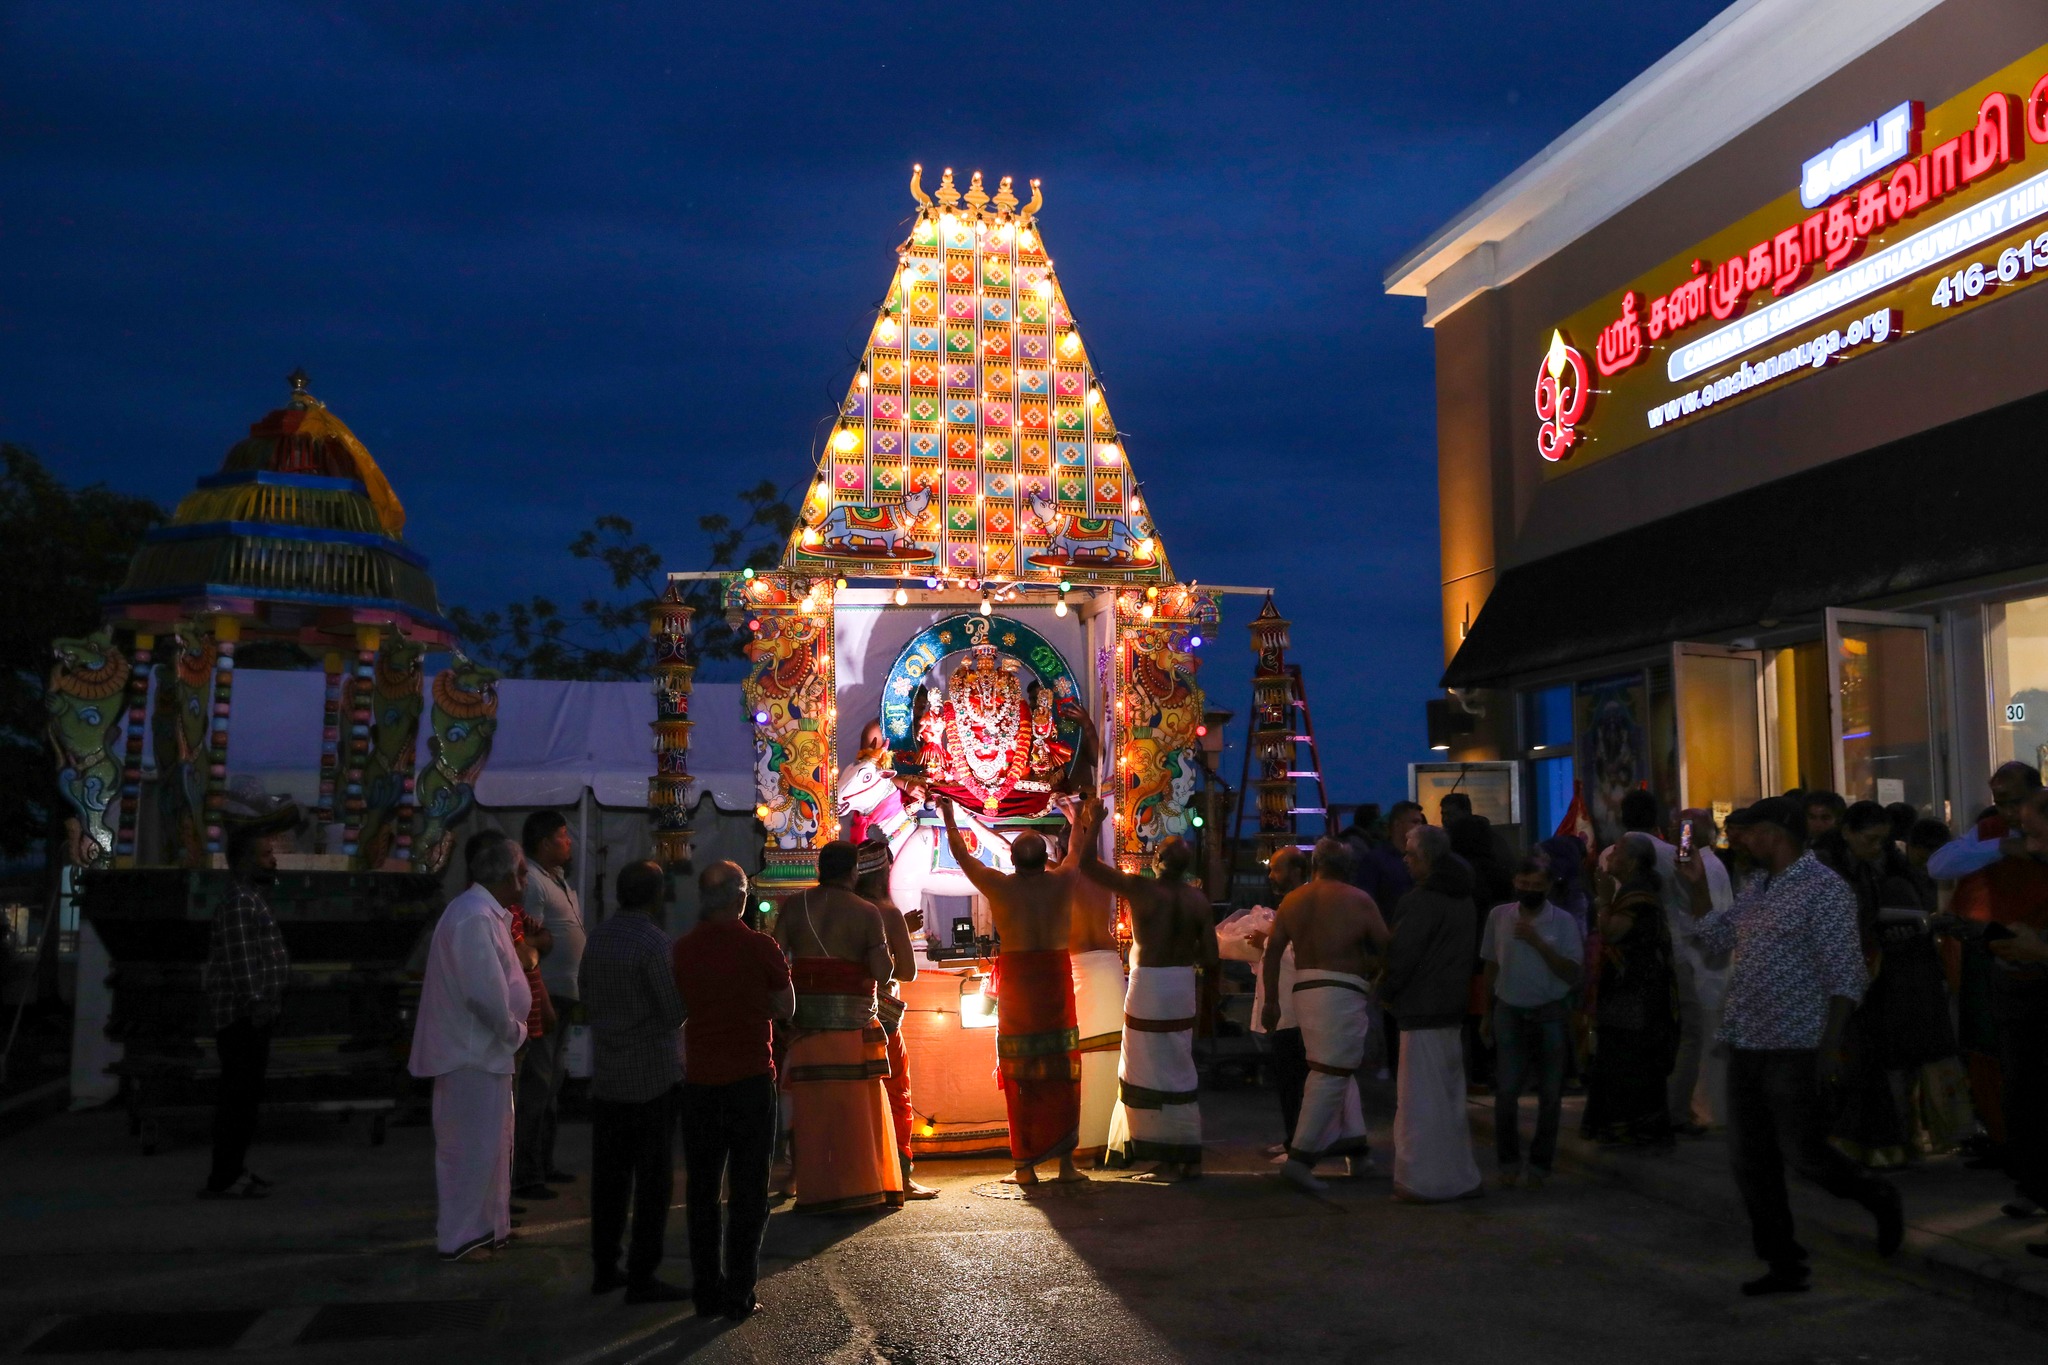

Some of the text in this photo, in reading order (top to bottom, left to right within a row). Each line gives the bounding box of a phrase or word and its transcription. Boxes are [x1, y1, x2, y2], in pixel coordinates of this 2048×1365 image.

[1647, 91, 2010, 340] சண்முகநாதசுவாமி
[1647, 307, 1890, 428] www.omshanmuga.org
[1682, 326, 1743, 371] CANADA
[1743, 314, 1768, 345] SRI
[2007, 704, 2024, 720] 30
